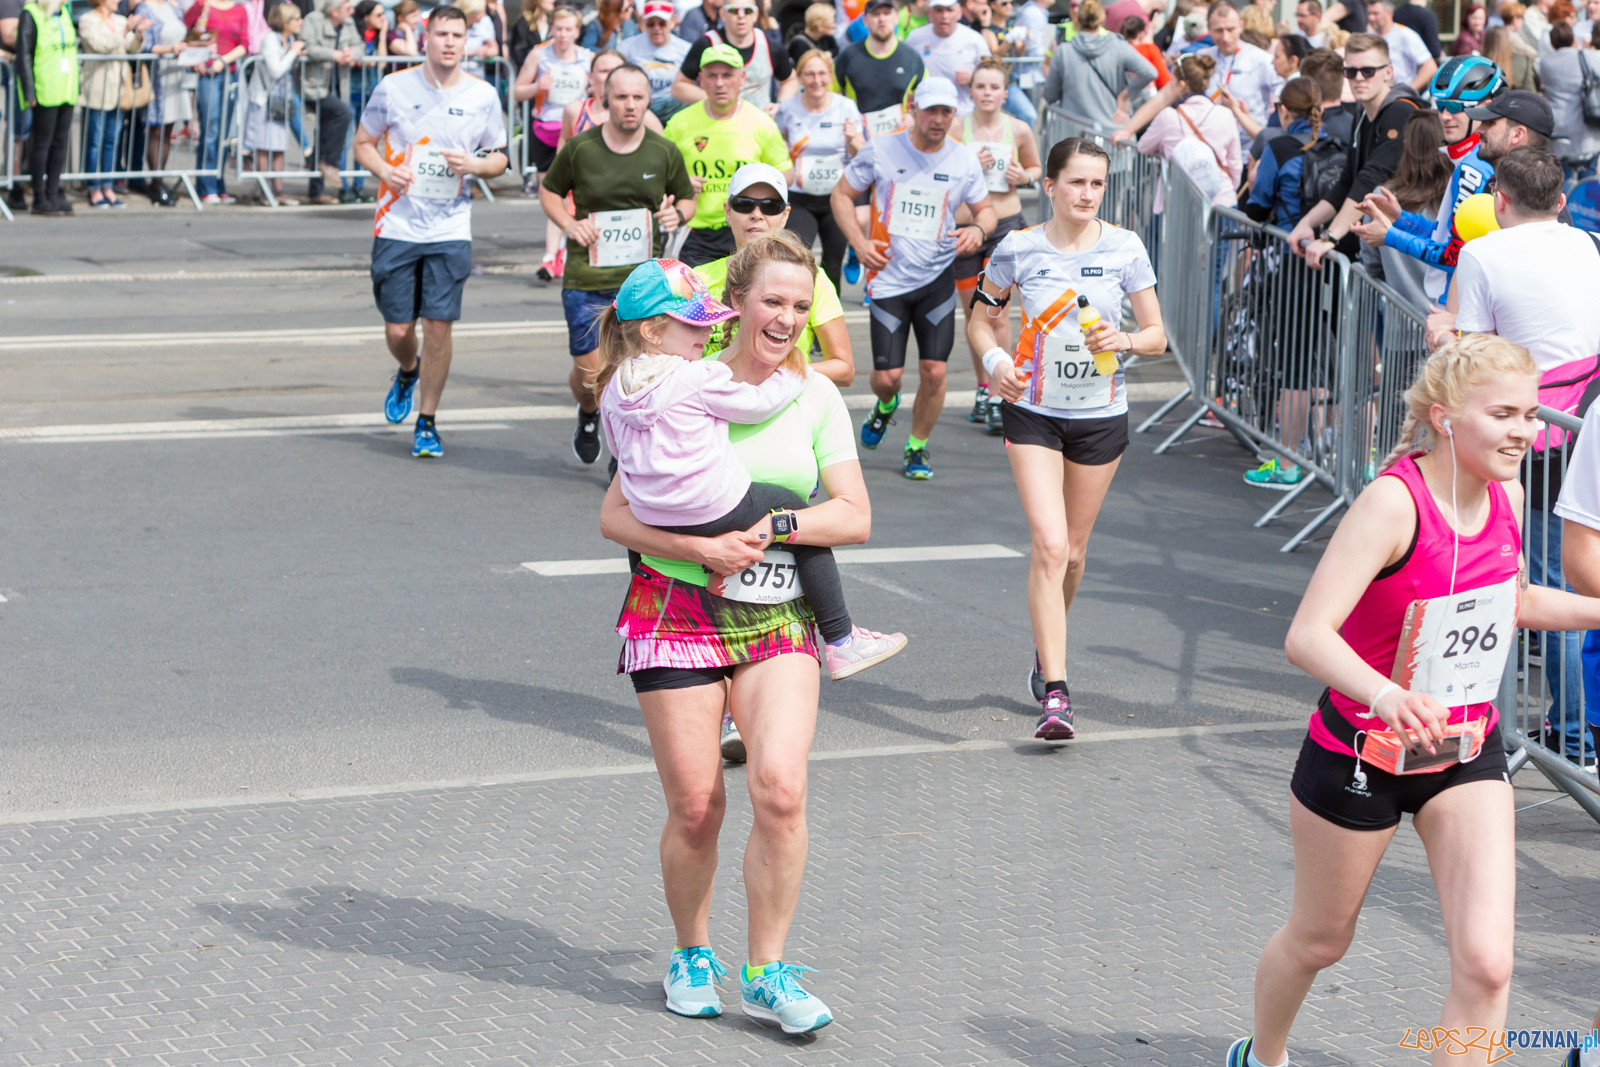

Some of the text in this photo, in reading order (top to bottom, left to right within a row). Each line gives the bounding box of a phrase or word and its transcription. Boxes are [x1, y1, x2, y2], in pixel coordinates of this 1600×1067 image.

[808, 169, 838, 180] 6535
[901, 201, 936, 218] 11511
[602, 226, 642, 243] 9760
[740, 562, 797, 590] 6757
[755, 594, 781, 602] Justyna
[1442, 622, 1498, 659] 296
[1453, 661, 1480, 671] Marta
